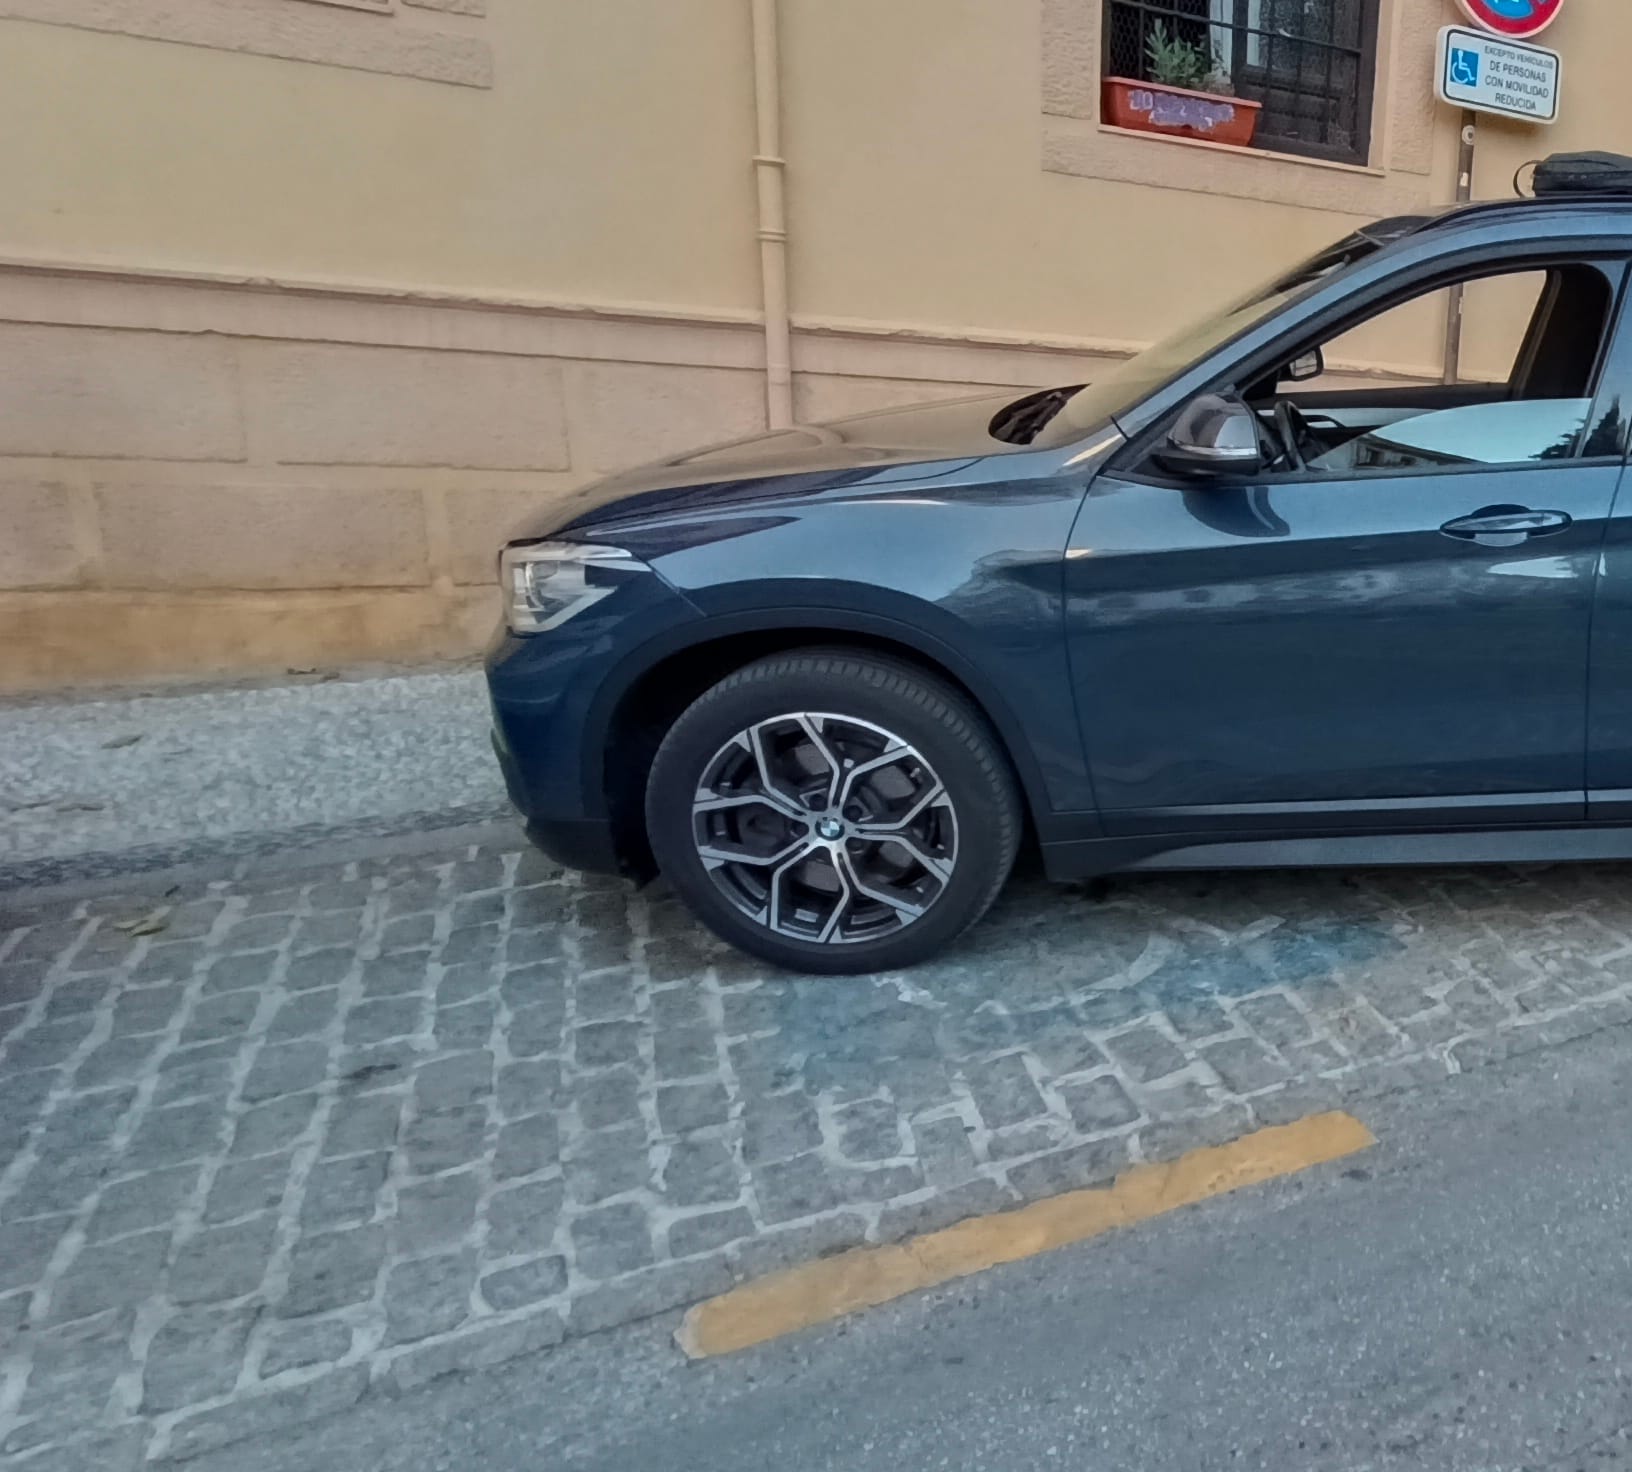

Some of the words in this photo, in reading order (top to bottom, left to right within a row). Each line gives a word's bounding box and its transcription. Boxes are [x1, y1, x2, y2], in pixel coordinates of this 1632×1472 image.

[1485, 45, 1515, 60] EXCEPTO
[1489, 60, 1500, 72] DE
[1503, 63, 1546, 82] PERSONAS
[1485, 75, 1503, 88] CON
[1505, 80, 1549, 98] MOVILIDAD
[1495, 93, 1536, 110] REDUCIDA
